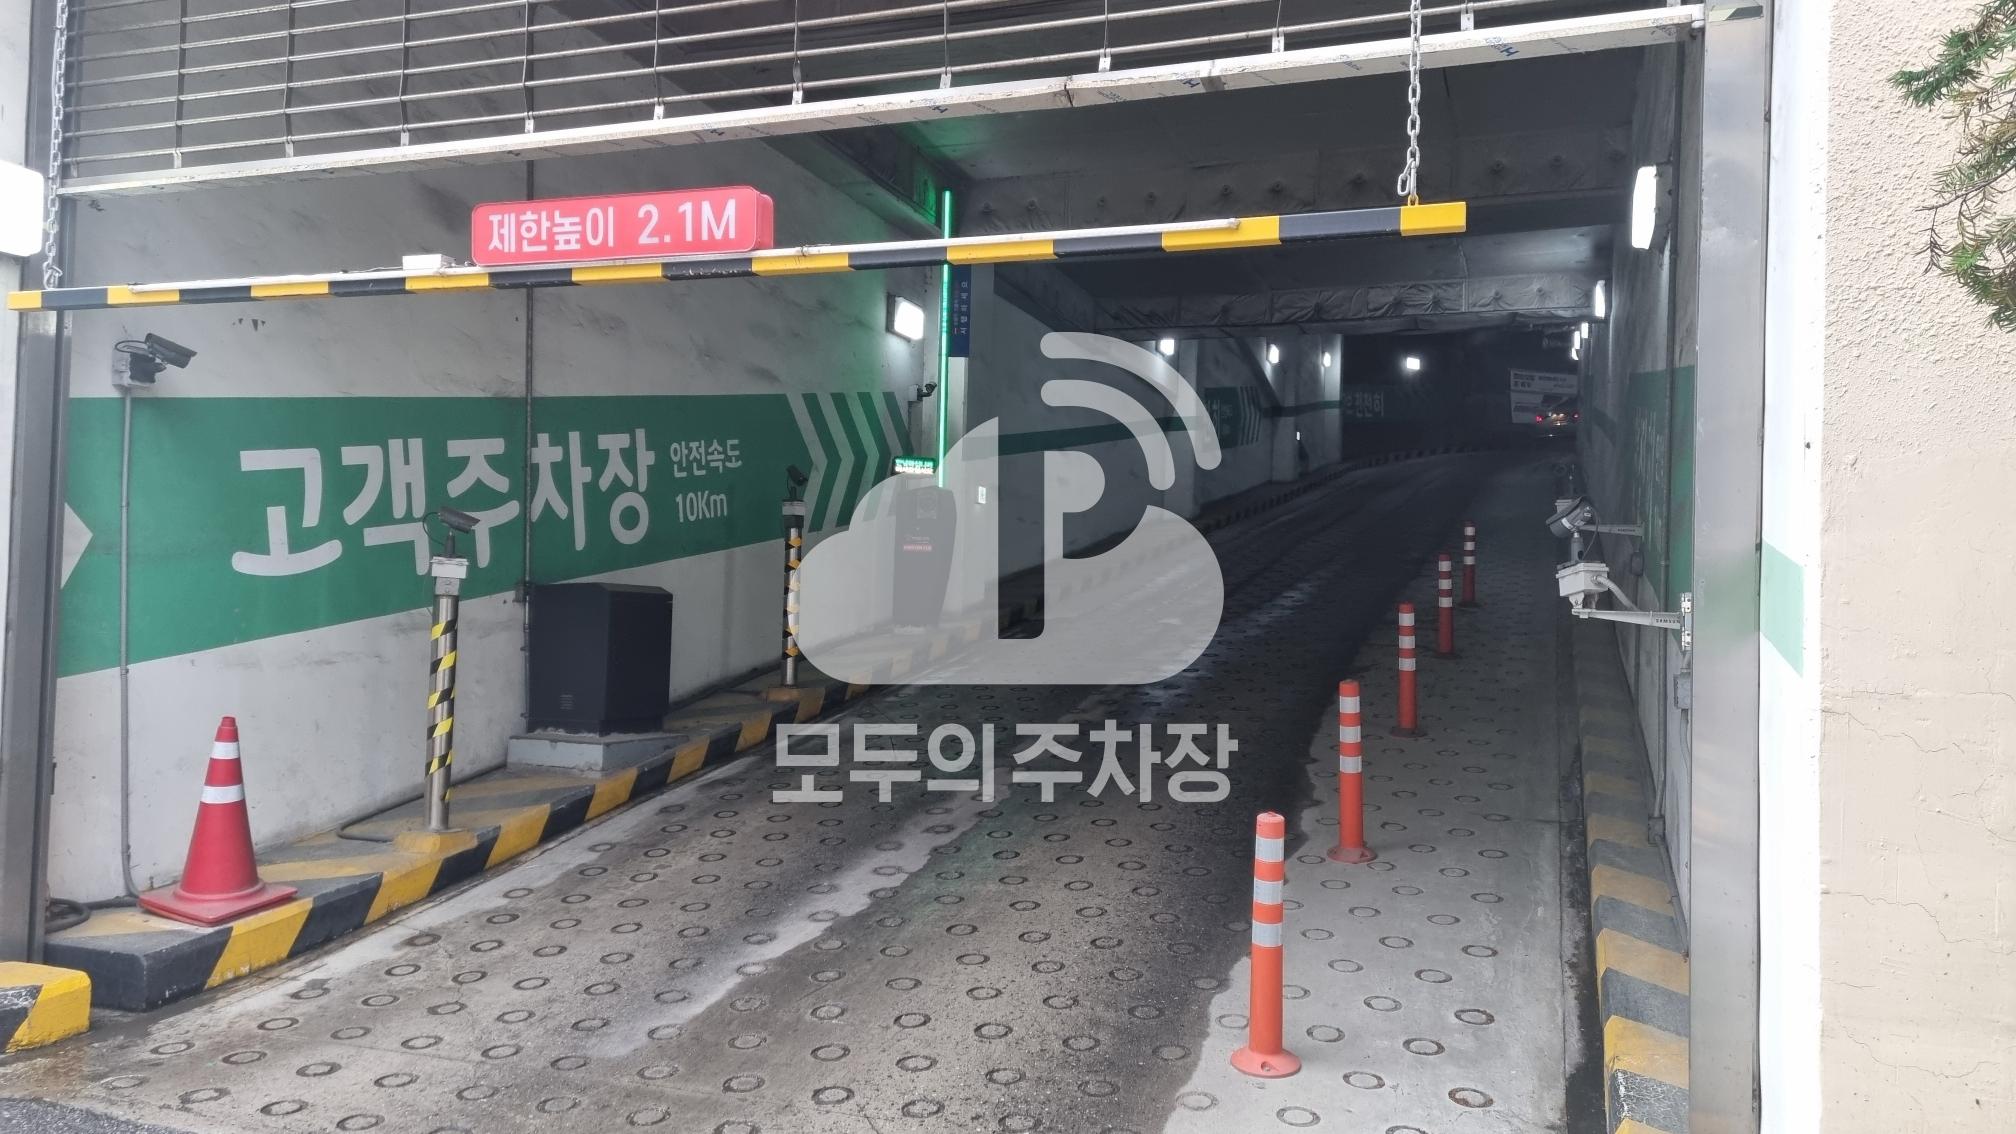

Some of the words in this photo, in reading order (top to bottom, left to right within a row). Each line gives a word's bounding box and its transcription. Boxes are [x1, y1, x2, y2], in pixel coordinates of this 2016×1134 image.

[488, 207, 614, 253] 제한높이
[637, 198, 736, 245] 2.1M
[670, 439, 743, 478] 안전속도
[231, 428, 656, 577] 고객주차장
[676, 490, 728, 522] 10Km
